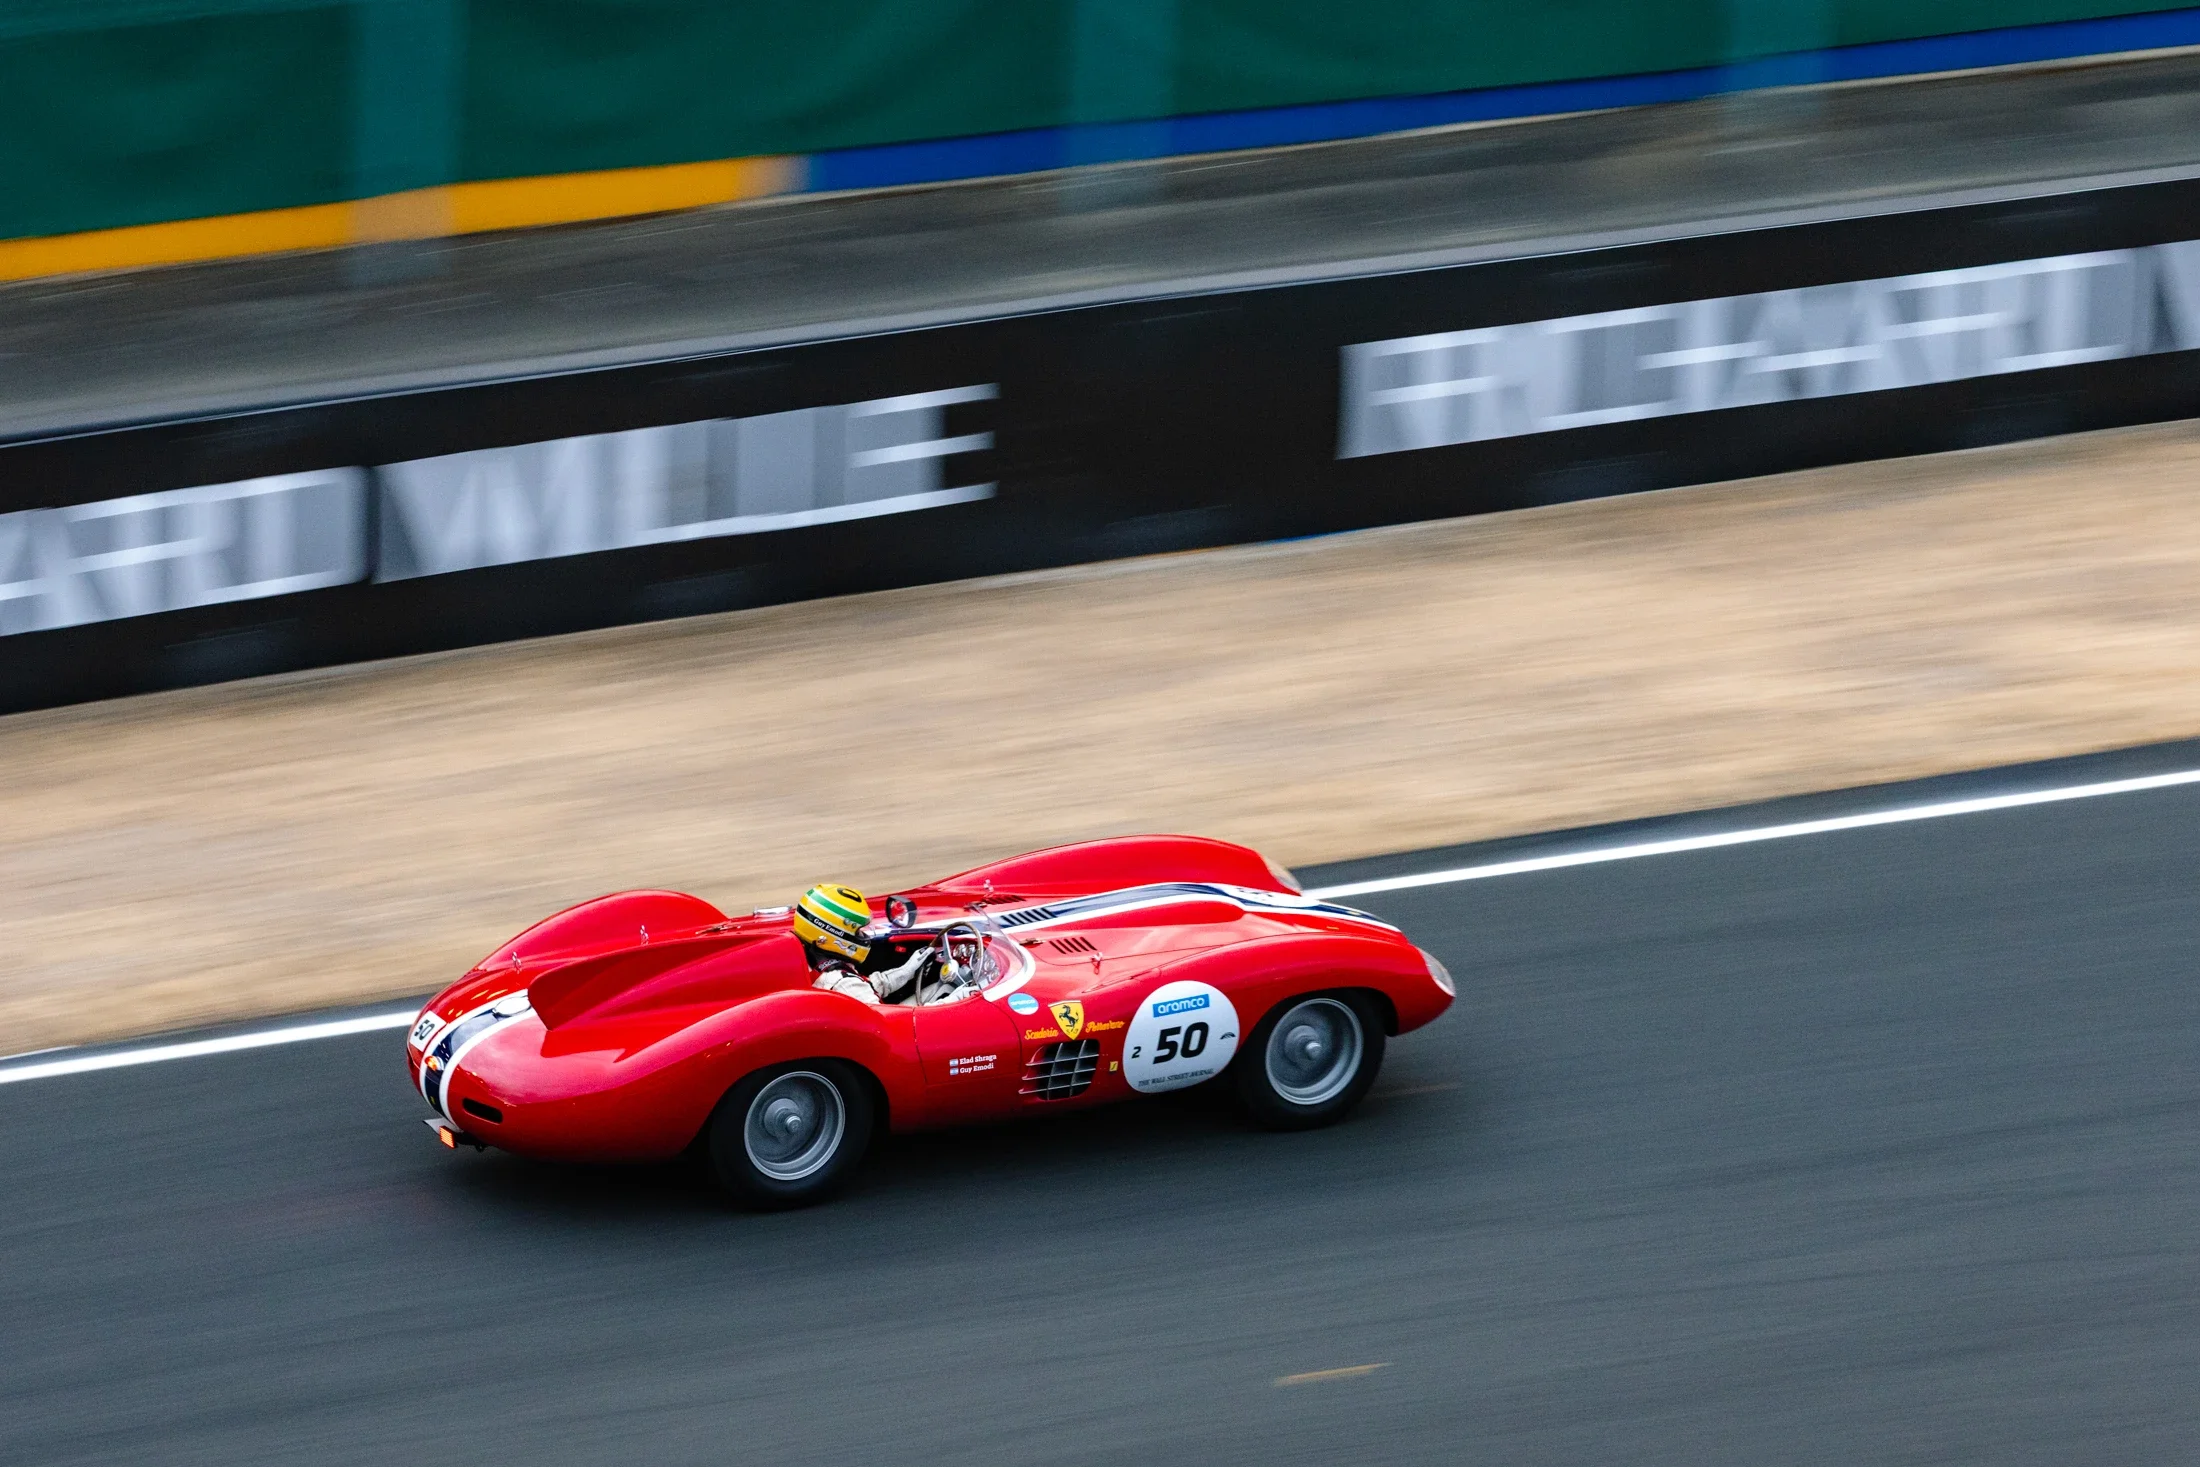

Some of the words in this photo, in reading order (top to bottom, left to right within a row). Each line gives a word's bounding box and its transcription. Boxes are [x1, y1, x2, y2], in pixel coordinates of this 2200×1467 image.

[813, 917, 825, 929] Guy
[825, 924, 845, 937] Emodi
[1157, 996, 1205, 1014] aramco
[414, 1019, 436, 1041] 50
[1024, 1026, 1059, 1040] Scuderia
[1152, 1021, 1209, 1065] 50
[959, 1056, 974, 1065] Elad
[1131, 1046, 1142, 1059] 2
[973, 1062, 994, 1072] Emodi
